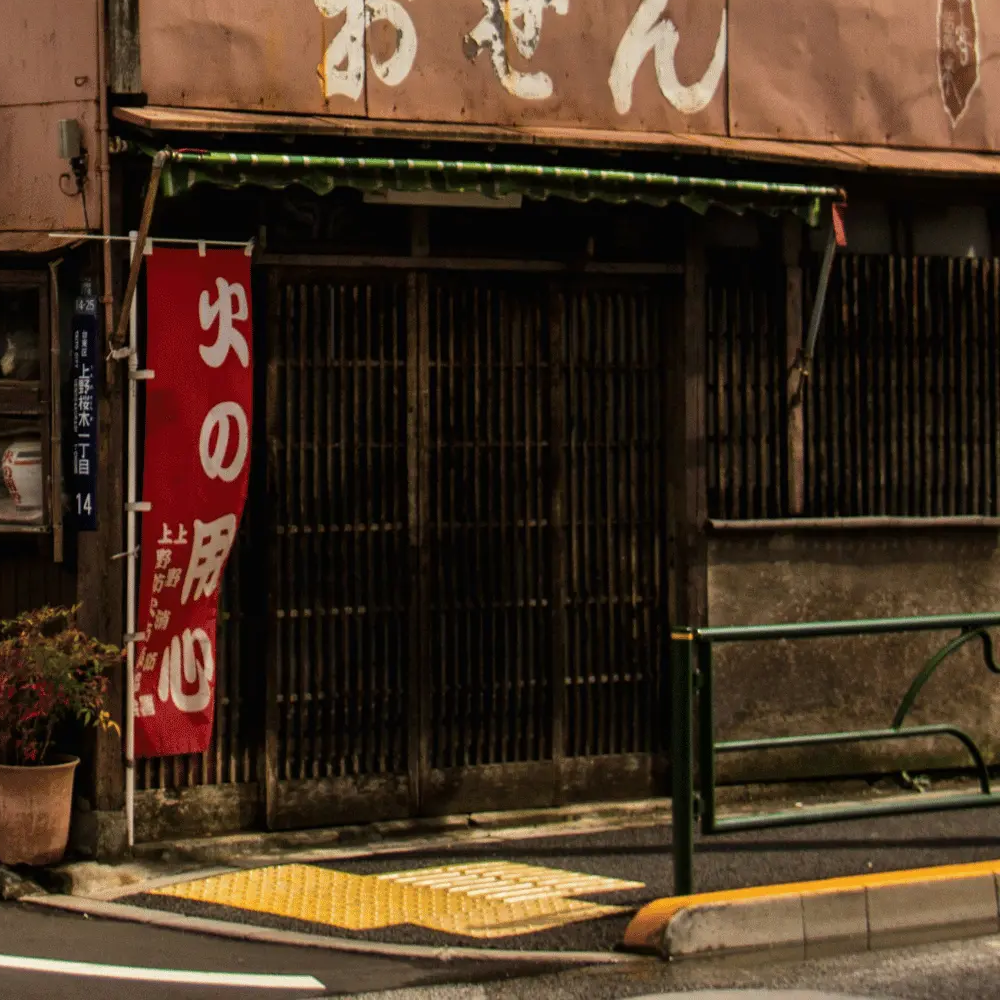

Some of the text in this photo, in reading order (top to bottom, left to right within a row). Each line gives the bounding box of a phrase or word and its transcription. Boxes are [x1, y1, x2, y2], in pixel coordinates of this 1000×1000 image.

[78, 363, 90, 475] 上野桜木一丁目
[75, 492, 92, 516] 14
[158, 276, 252, 713] 火の用心
